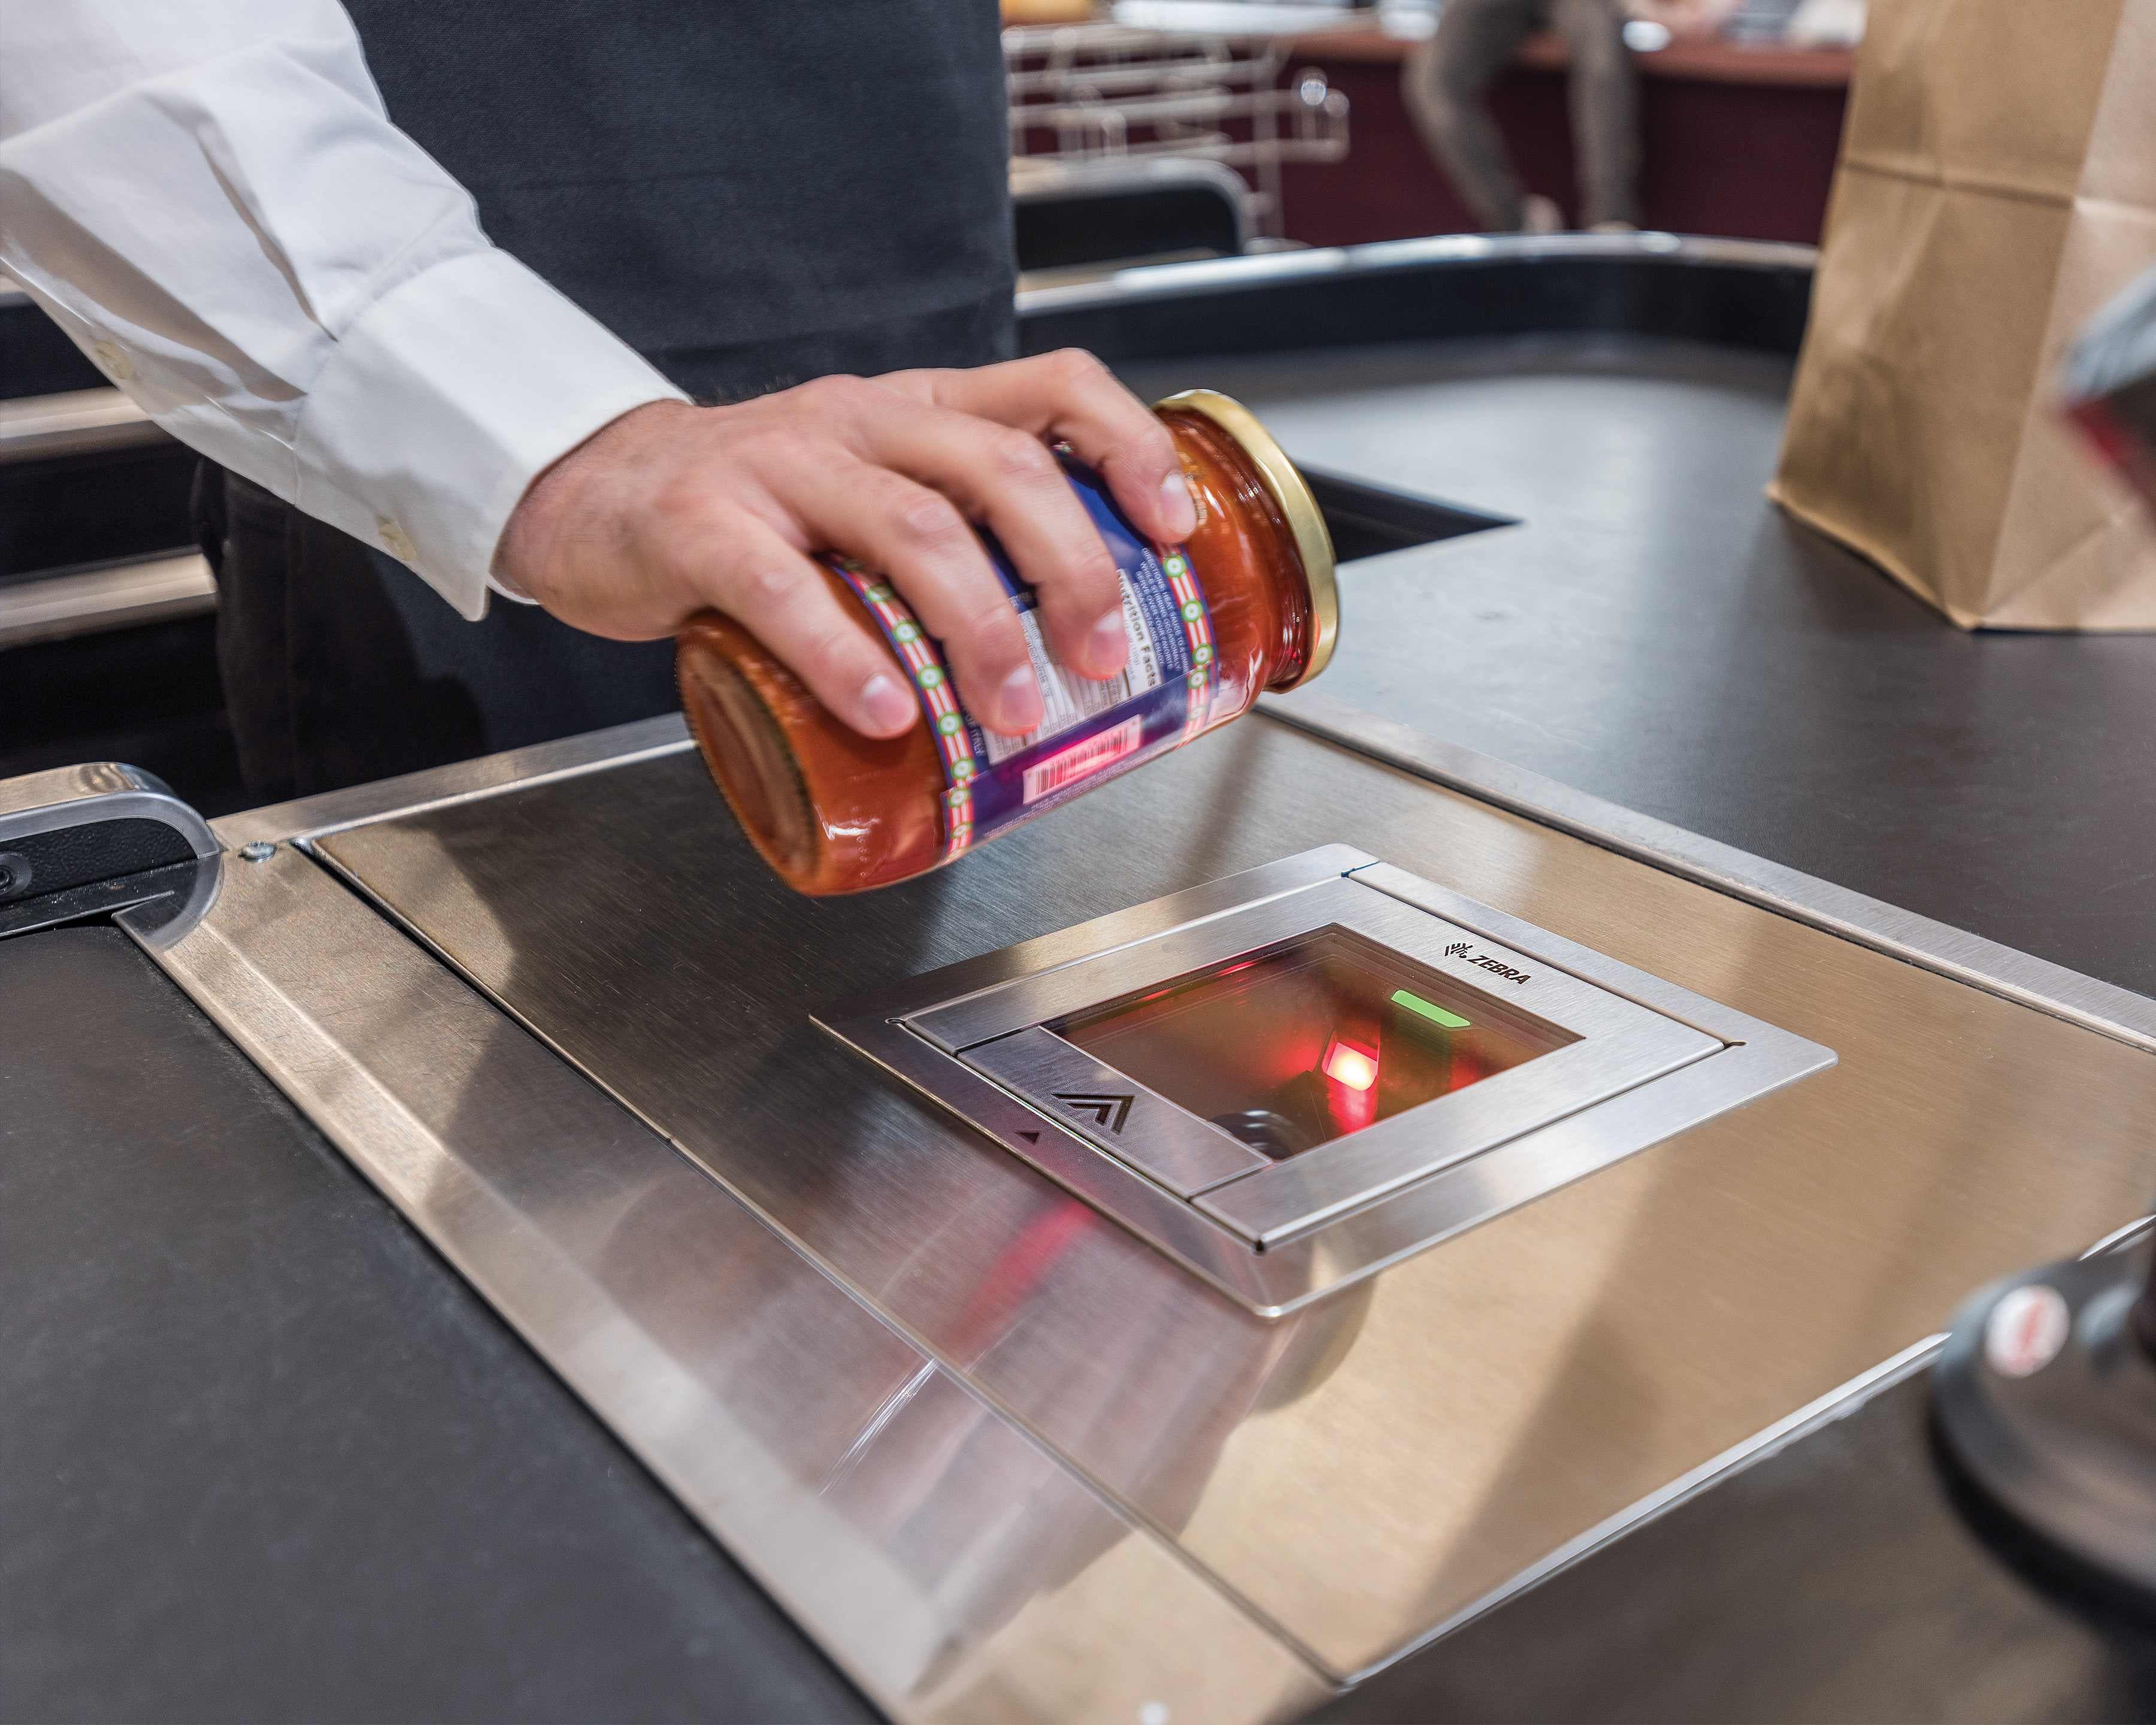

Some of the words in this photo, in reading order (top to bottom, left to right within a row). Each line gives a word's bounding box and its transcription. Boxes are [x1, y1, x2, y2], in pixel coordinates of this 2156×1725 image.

[1140, 561, 1154, 585] WHILE
[1150, 585, 1167, 619] STIRRING
[1162, 591, 1174, 612] HEAT
[1135, 571, 1150, 594] SERVE
[1146, 594, 1159, 617] OVER
[1155, 616, 1165, 637] YOUR
[1160, 637, 1173, 670] FAVORITE
[1141, 603, 1154, 626] PASTA
[1149, 627, 1158, 644] AND
[1140, 644, 1156, 686] Facts
[1466, 955, 1531, 985] ZEBRA
